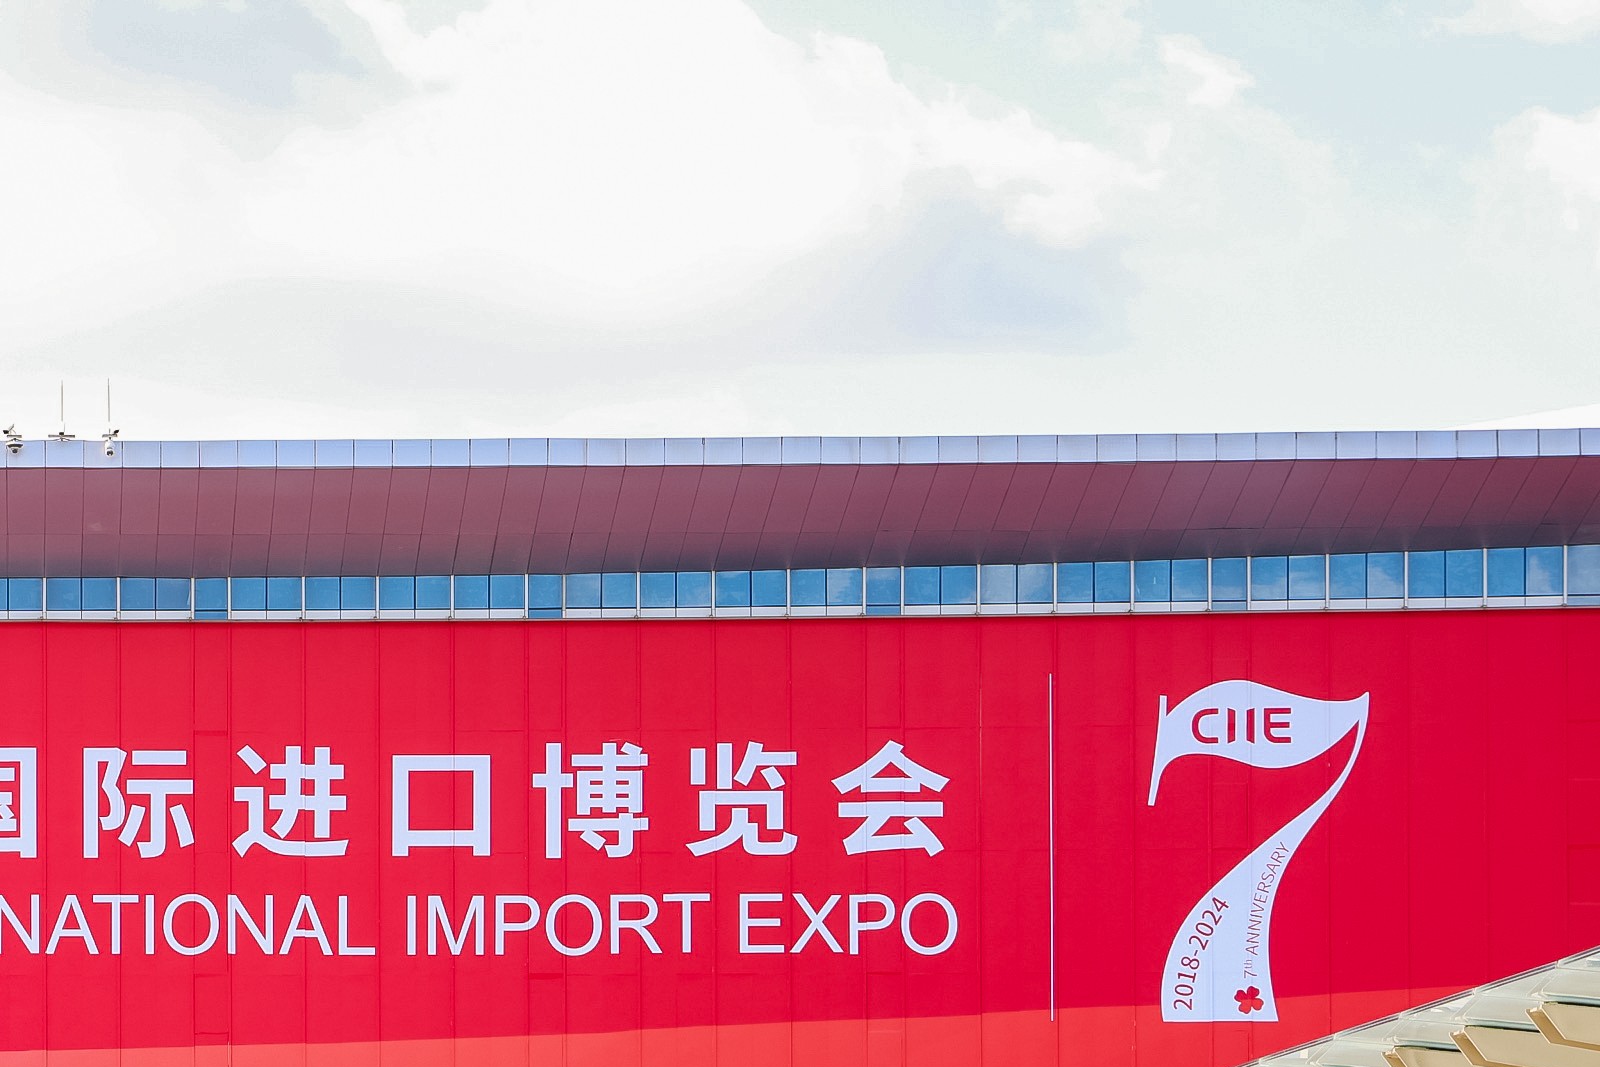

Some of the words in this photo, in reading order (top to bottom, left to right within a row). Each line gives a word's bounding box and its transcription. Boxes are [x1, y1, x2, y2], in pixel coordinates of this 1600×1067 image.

[1191, 707, 1292, 744] CIIE
[408, 894, 710, 956] IMPORT
[740, 893, 957, 955] EXPO
[1244, 841, 1291, 957] ANNIVERSARY
[1172, 896, 1230, 1011] 2018-2024
